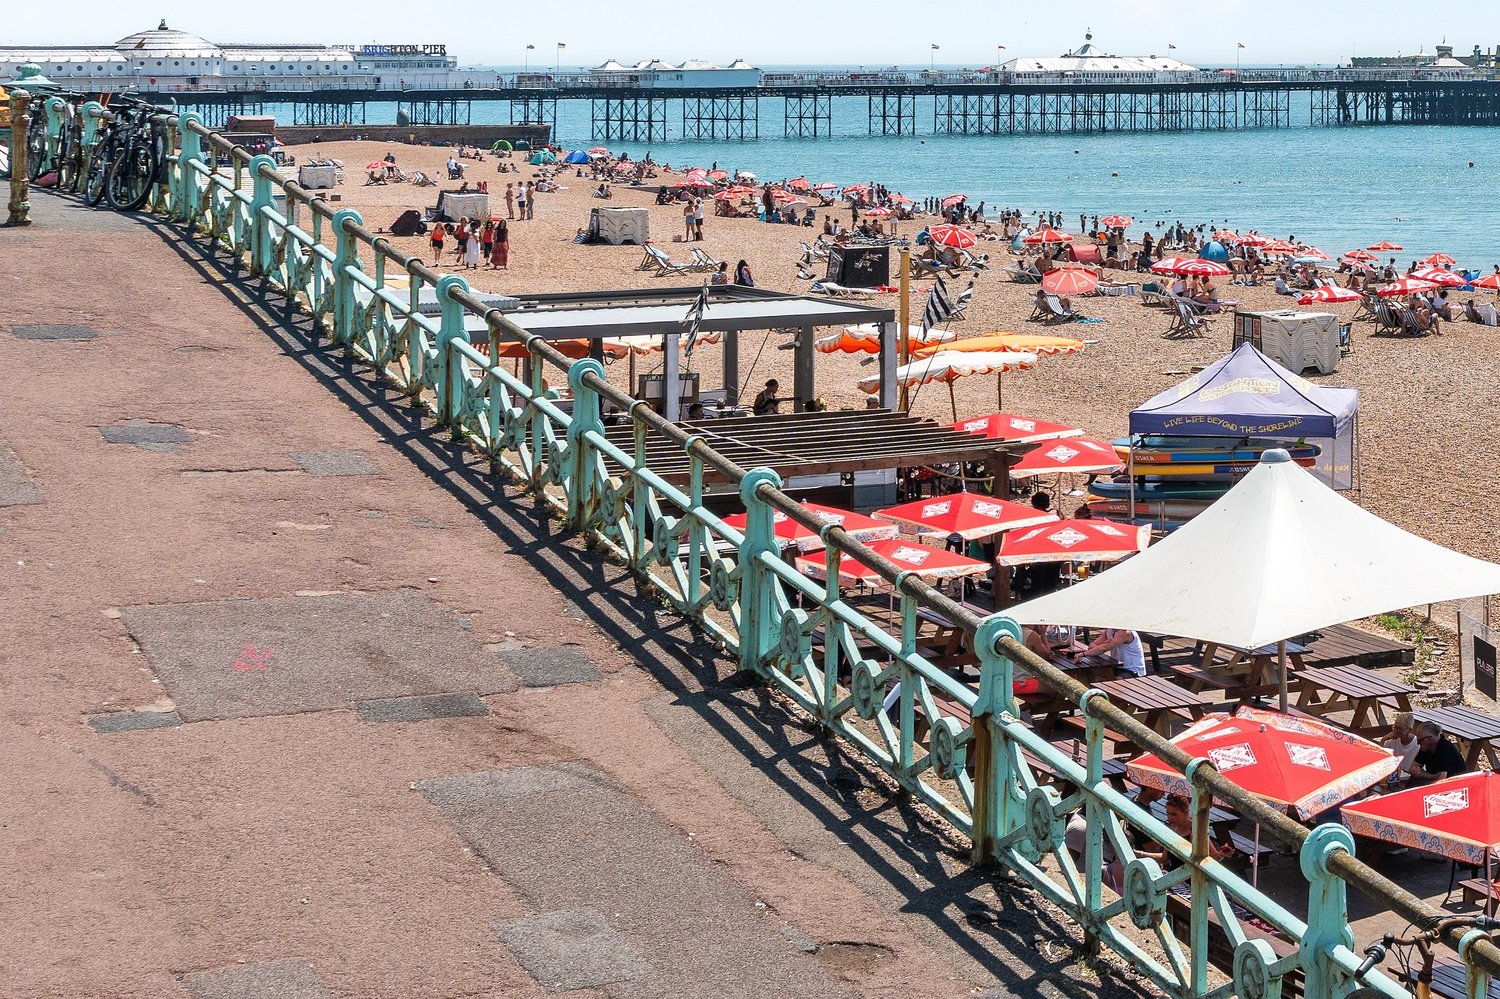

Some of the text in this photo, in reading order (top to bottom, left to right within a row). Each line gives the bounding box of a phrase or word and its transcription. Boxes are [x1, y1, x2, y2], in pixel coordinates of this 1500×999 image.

[364, 44, 447, 55] BRIGHTON PIER
[1163, 415, 1303, 434] LIVE LIFE BEYOND THE SHORELINE
[1476, 657, 1495, 676] PLAYERS
